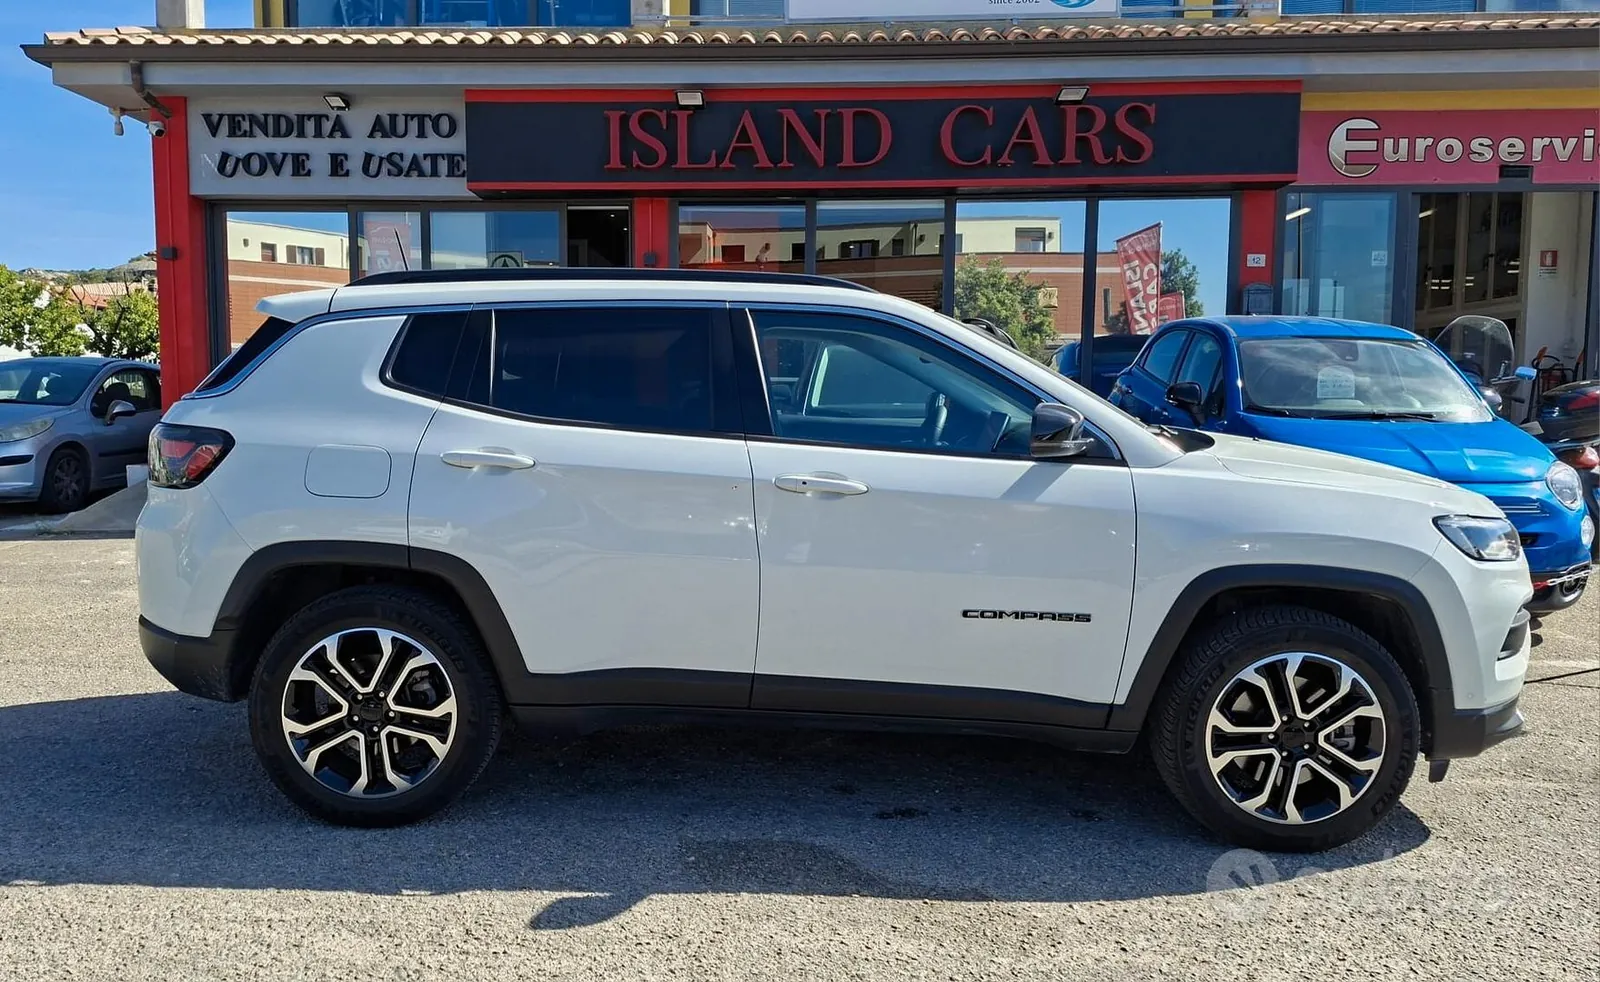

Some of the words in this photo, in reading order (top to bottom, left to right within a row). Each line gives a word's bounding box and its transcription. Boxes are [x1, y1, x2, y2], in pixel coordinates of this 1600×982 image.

[367, 113, 457, 139] AUTO
[603, 107, 893, 170] ISLAND
[939, 102, 1156, 166] CARS
[1327, 117, 1600, 178] Euroservi
[328, 153, 350, 178] E
[361, 151, 467, 178] USATE
[962, 609, 1092, 623] COMPASS
